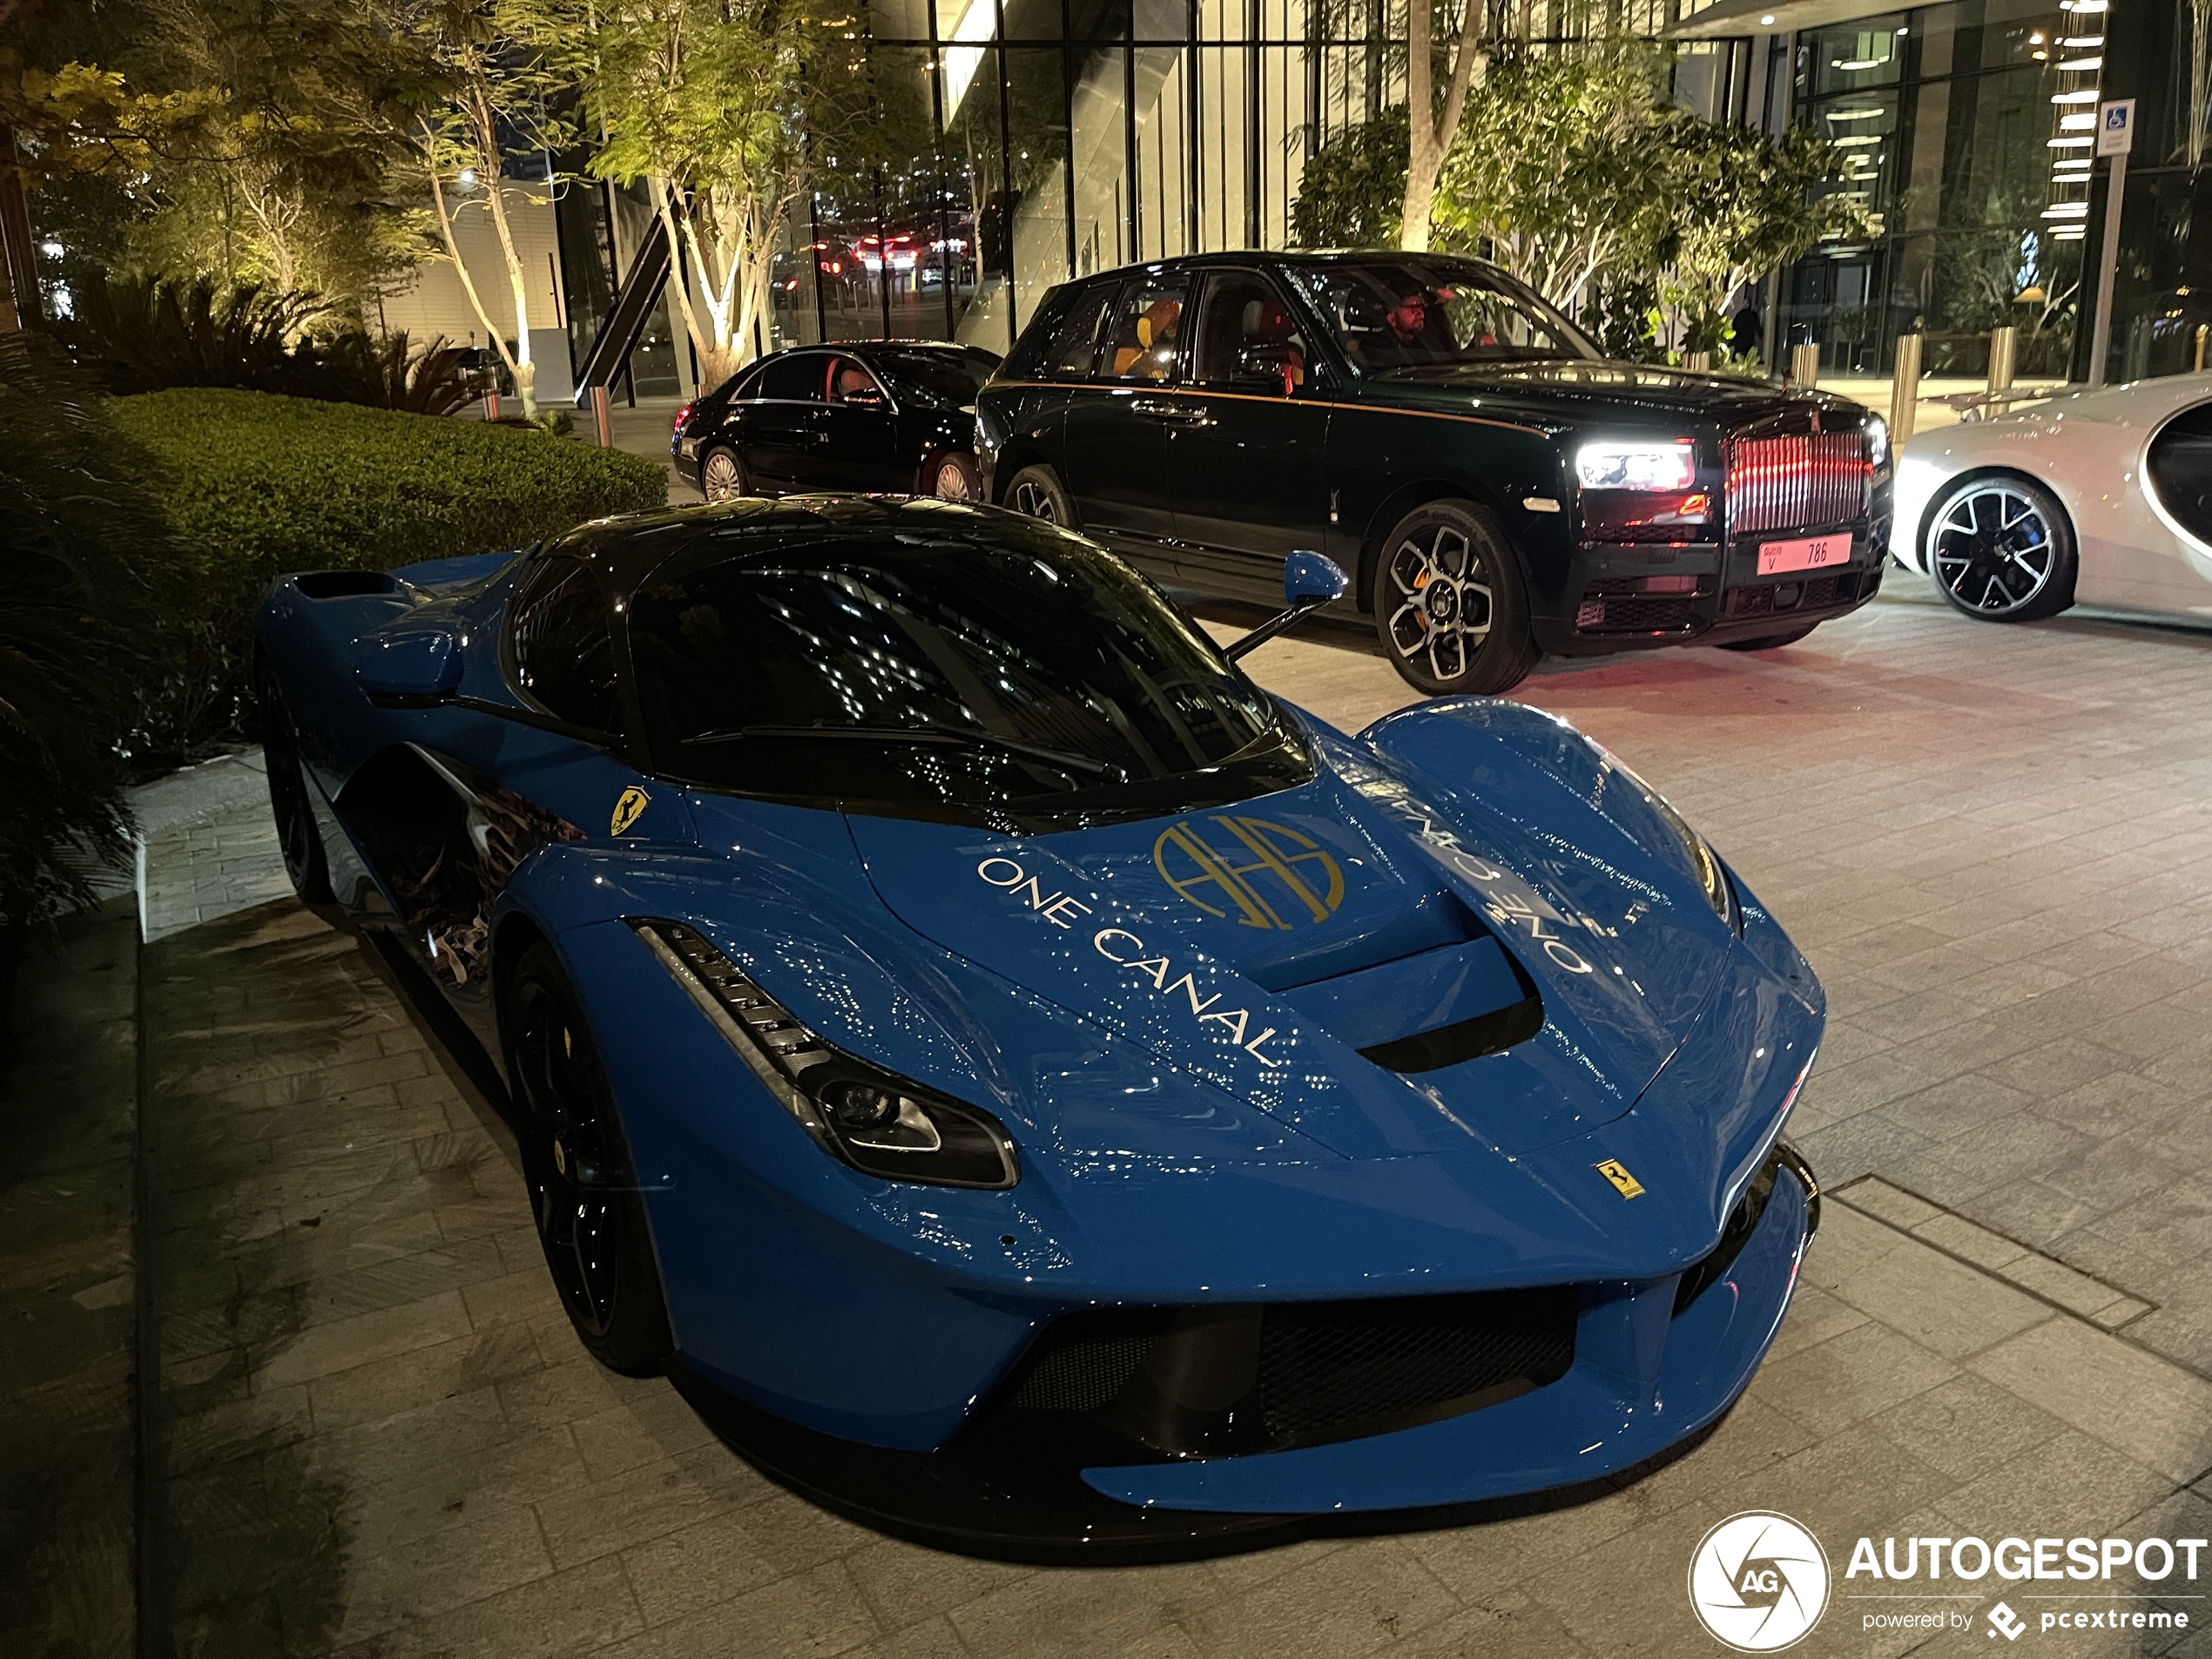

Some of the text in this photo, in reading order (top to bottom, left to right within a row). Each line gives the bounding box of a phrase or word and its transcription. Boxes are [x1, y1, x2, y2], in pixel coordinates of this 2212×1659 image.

[1769, 541, 1828, 570] V 786
[978, 857, 1278, 1068] ONE CANAL
[1379, 791, 1588, 974] ONE CANA
